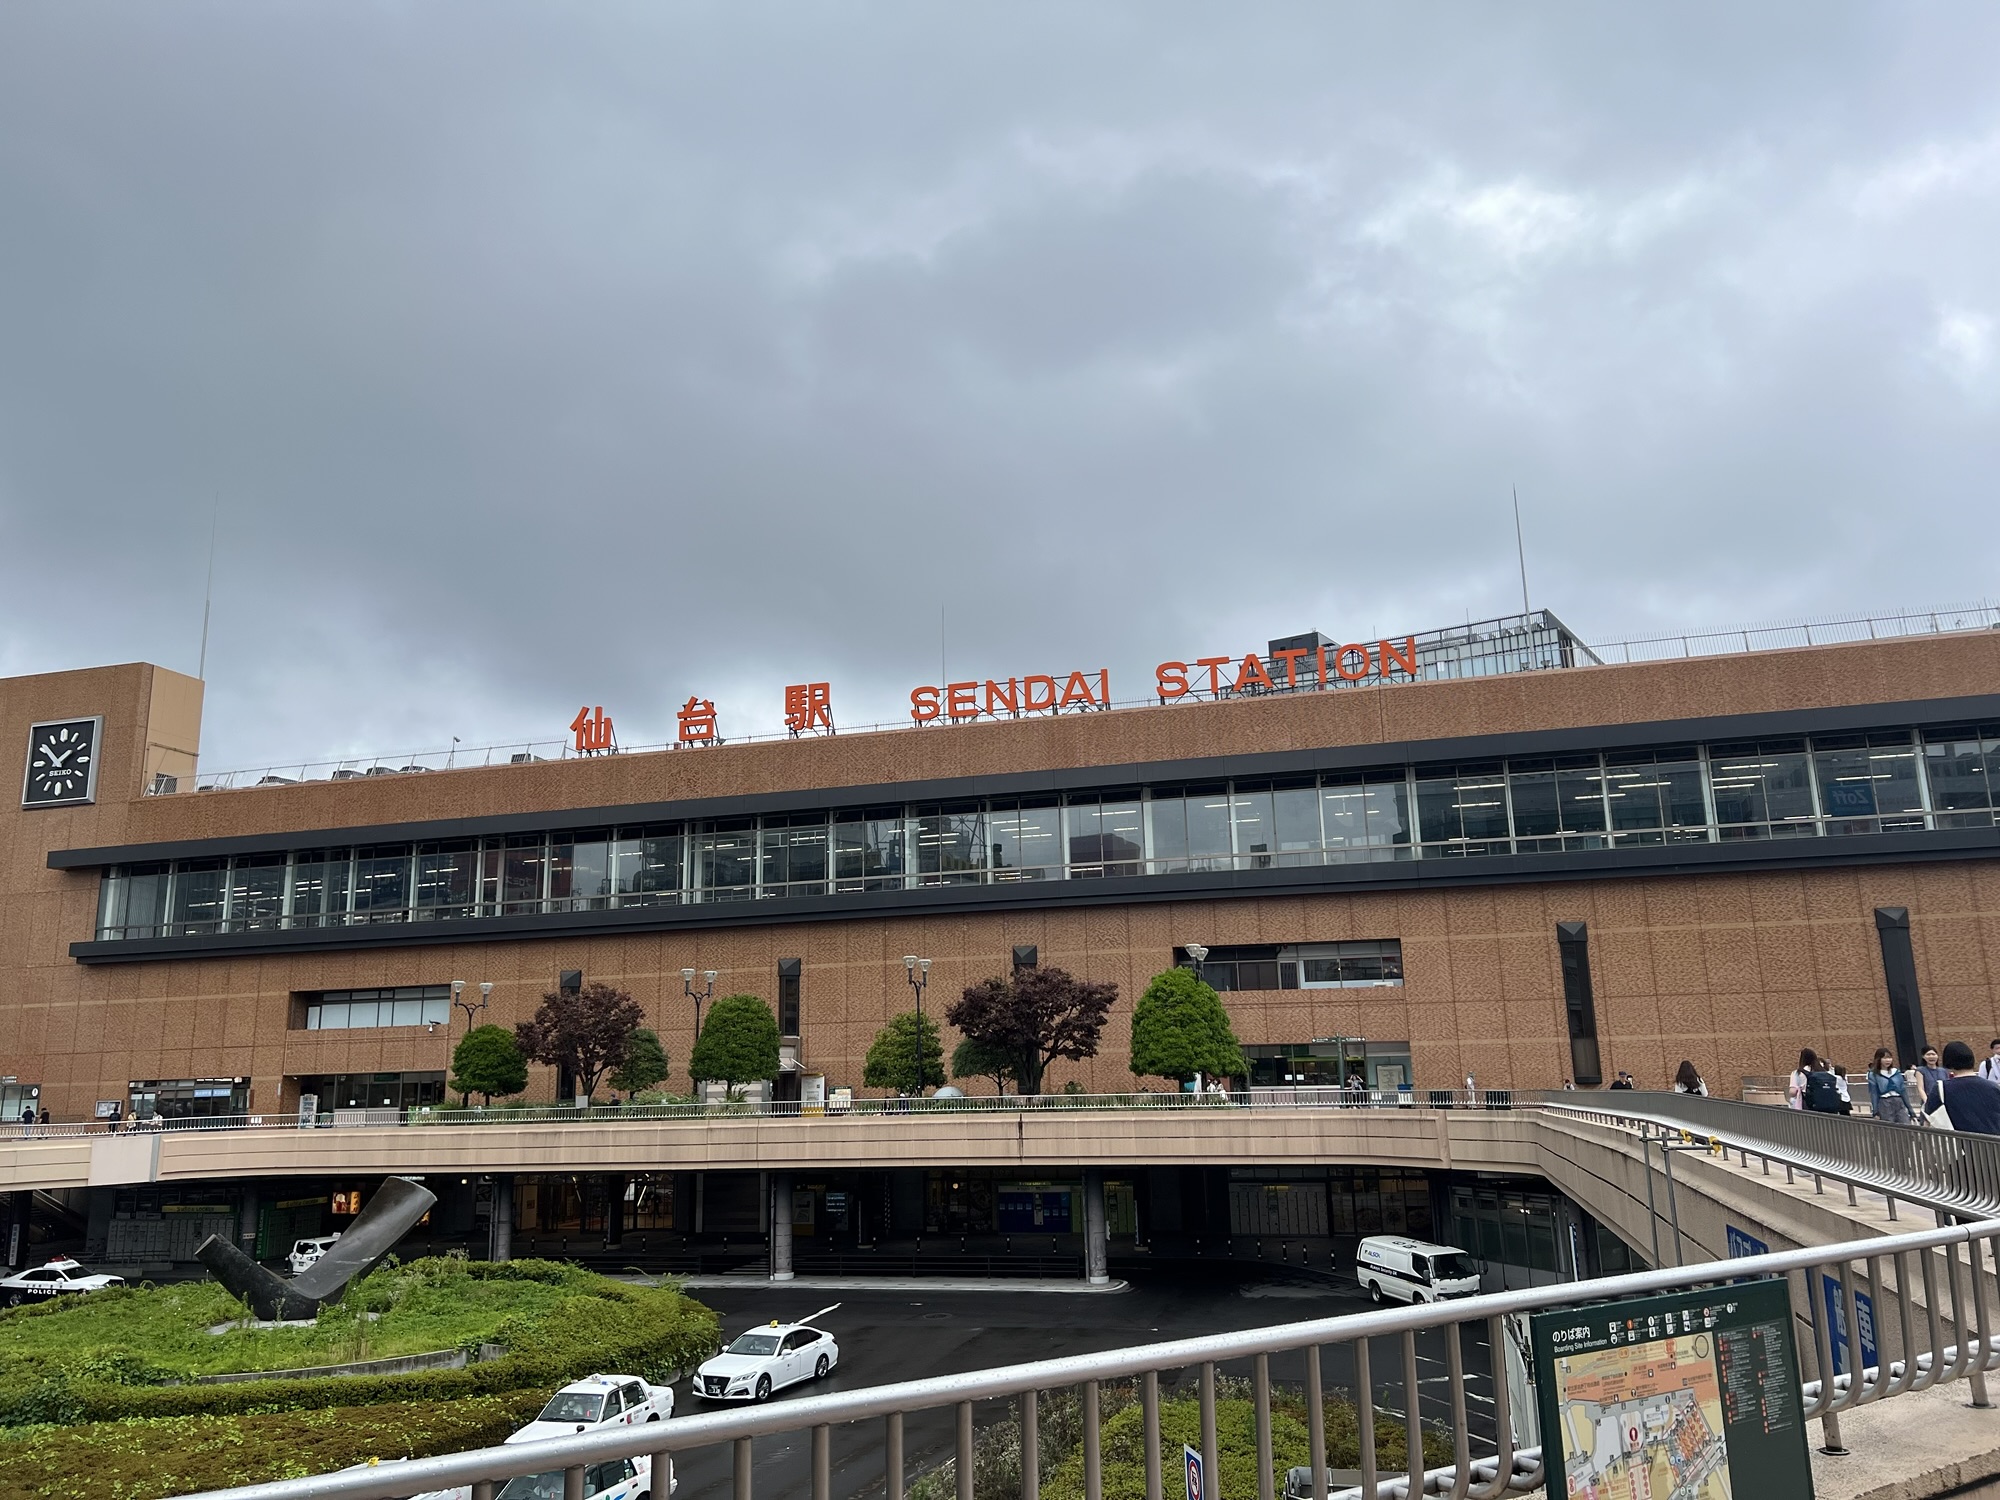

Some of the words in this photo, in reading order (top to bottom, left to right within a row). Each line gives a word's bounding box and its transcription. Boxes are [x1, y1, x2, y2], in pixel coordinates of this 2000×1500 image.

[910, 668, 1110, 721] SENDAI
[1155, 637, 1417, 698] STATION
[569, 682, 830, 751] 仙台駅
[49, 769, 72, 777] SEIKO
[1552, 1326, 1591, 1342] のりば案内
[1554, 1344, 1574, 1353] Boarding
[1574, 1342, 1583, 1350] Site
[1583, 1339, 1608, 1348] Information
